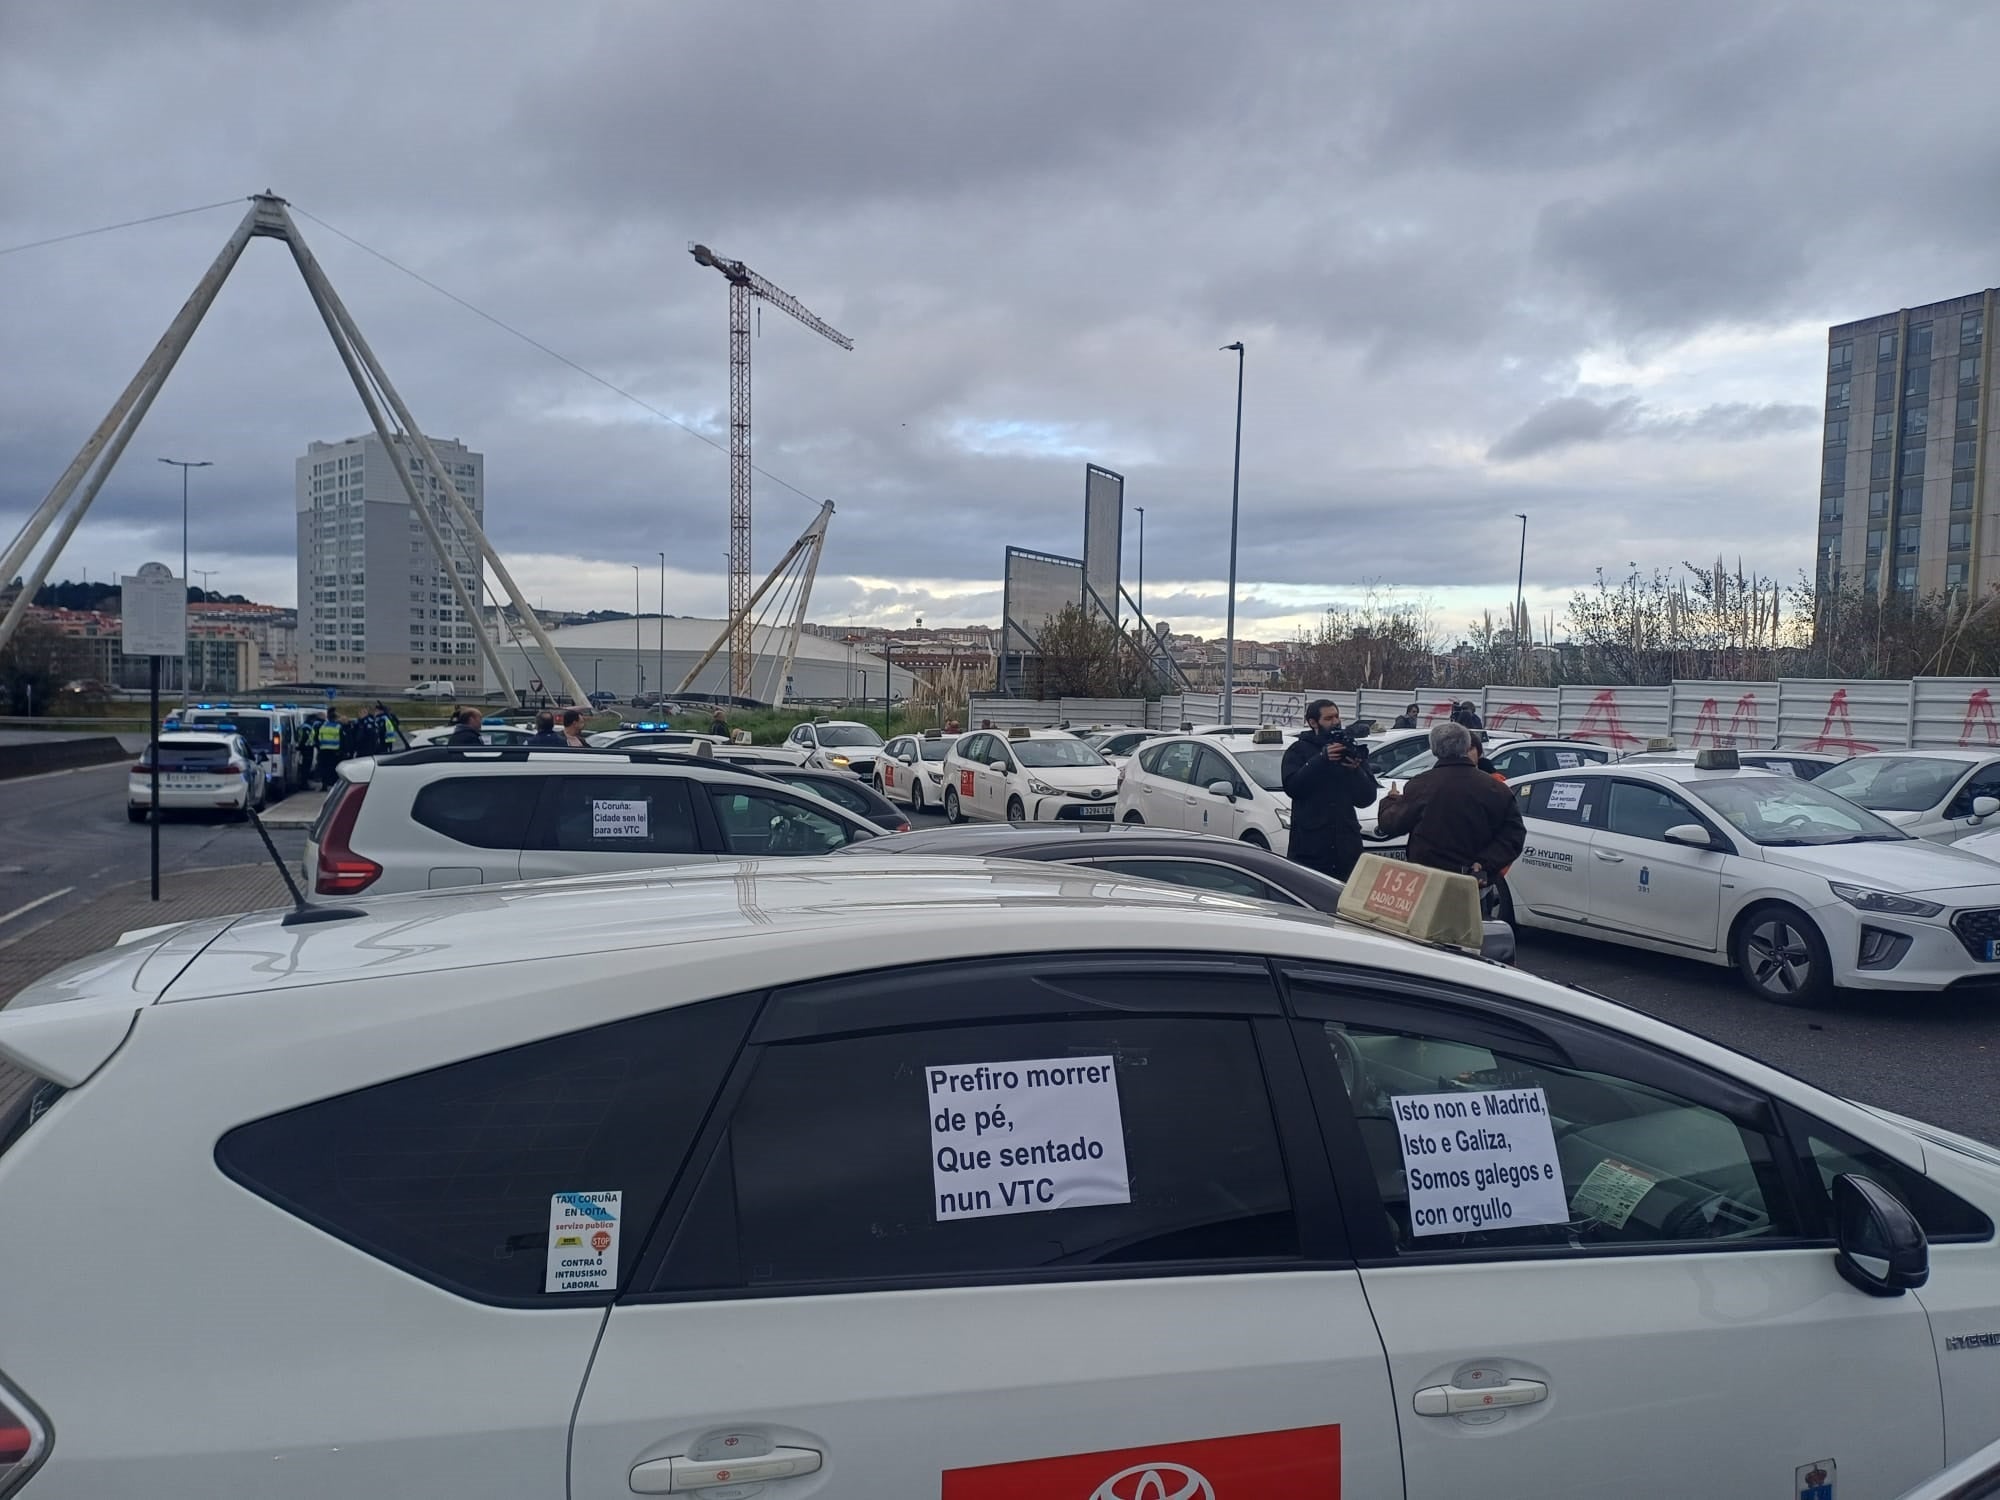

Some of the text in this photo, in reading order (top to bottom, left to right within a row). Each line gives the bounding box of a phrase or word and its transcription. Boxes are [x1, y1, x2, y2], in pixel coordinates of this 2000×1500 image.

[595, 801, 632, 810] A Coruña:
[595, 813, 621, 822] Cidade
[638, 813, 647, 822] lei
[595, 827, 611, 835] para
[624, 825, 640, 834] VTC
[1538, 849, 1573, 863] HYUNDAI
[1522, 858, 1573, 872] FINISTERRE MOTOR
[1382, 869, 1420, 897] 154
[1370, 890, 1395, 906] RADIO
[1395, 898, 1413, 912] TAXI
[931, 1065, 1111, 1094] Prefiro morrer
[1396, 1092, 1546, 1121] Isto non e Madrid,
[934, 1103, 1014, 1136] de pé,
[1404, 1129, 1512, 1155] Isto e Galiza,
[937, 1136, 1104, 1173] Que sentado
[1410, 1162, 1554, 1191] Somos galegos e
[555, 1193, 618, 1205] TAXI CORUÑA
[940, 1178, 1055, 1213] nun VTC
[565, 1207, 607, 1217] EN LOITA
[1415, 1197, 1513, 1227] con orgullo
[555, 1222, 614, 1231] servizo publico
[592, 1237, 610, 1246] STOP
[561, 1258, 603, 1267] CONTRA O
[555, 1269, 608, 1279] INTRUSISMO
[561, 1281, 600, 1289] LABORAL
